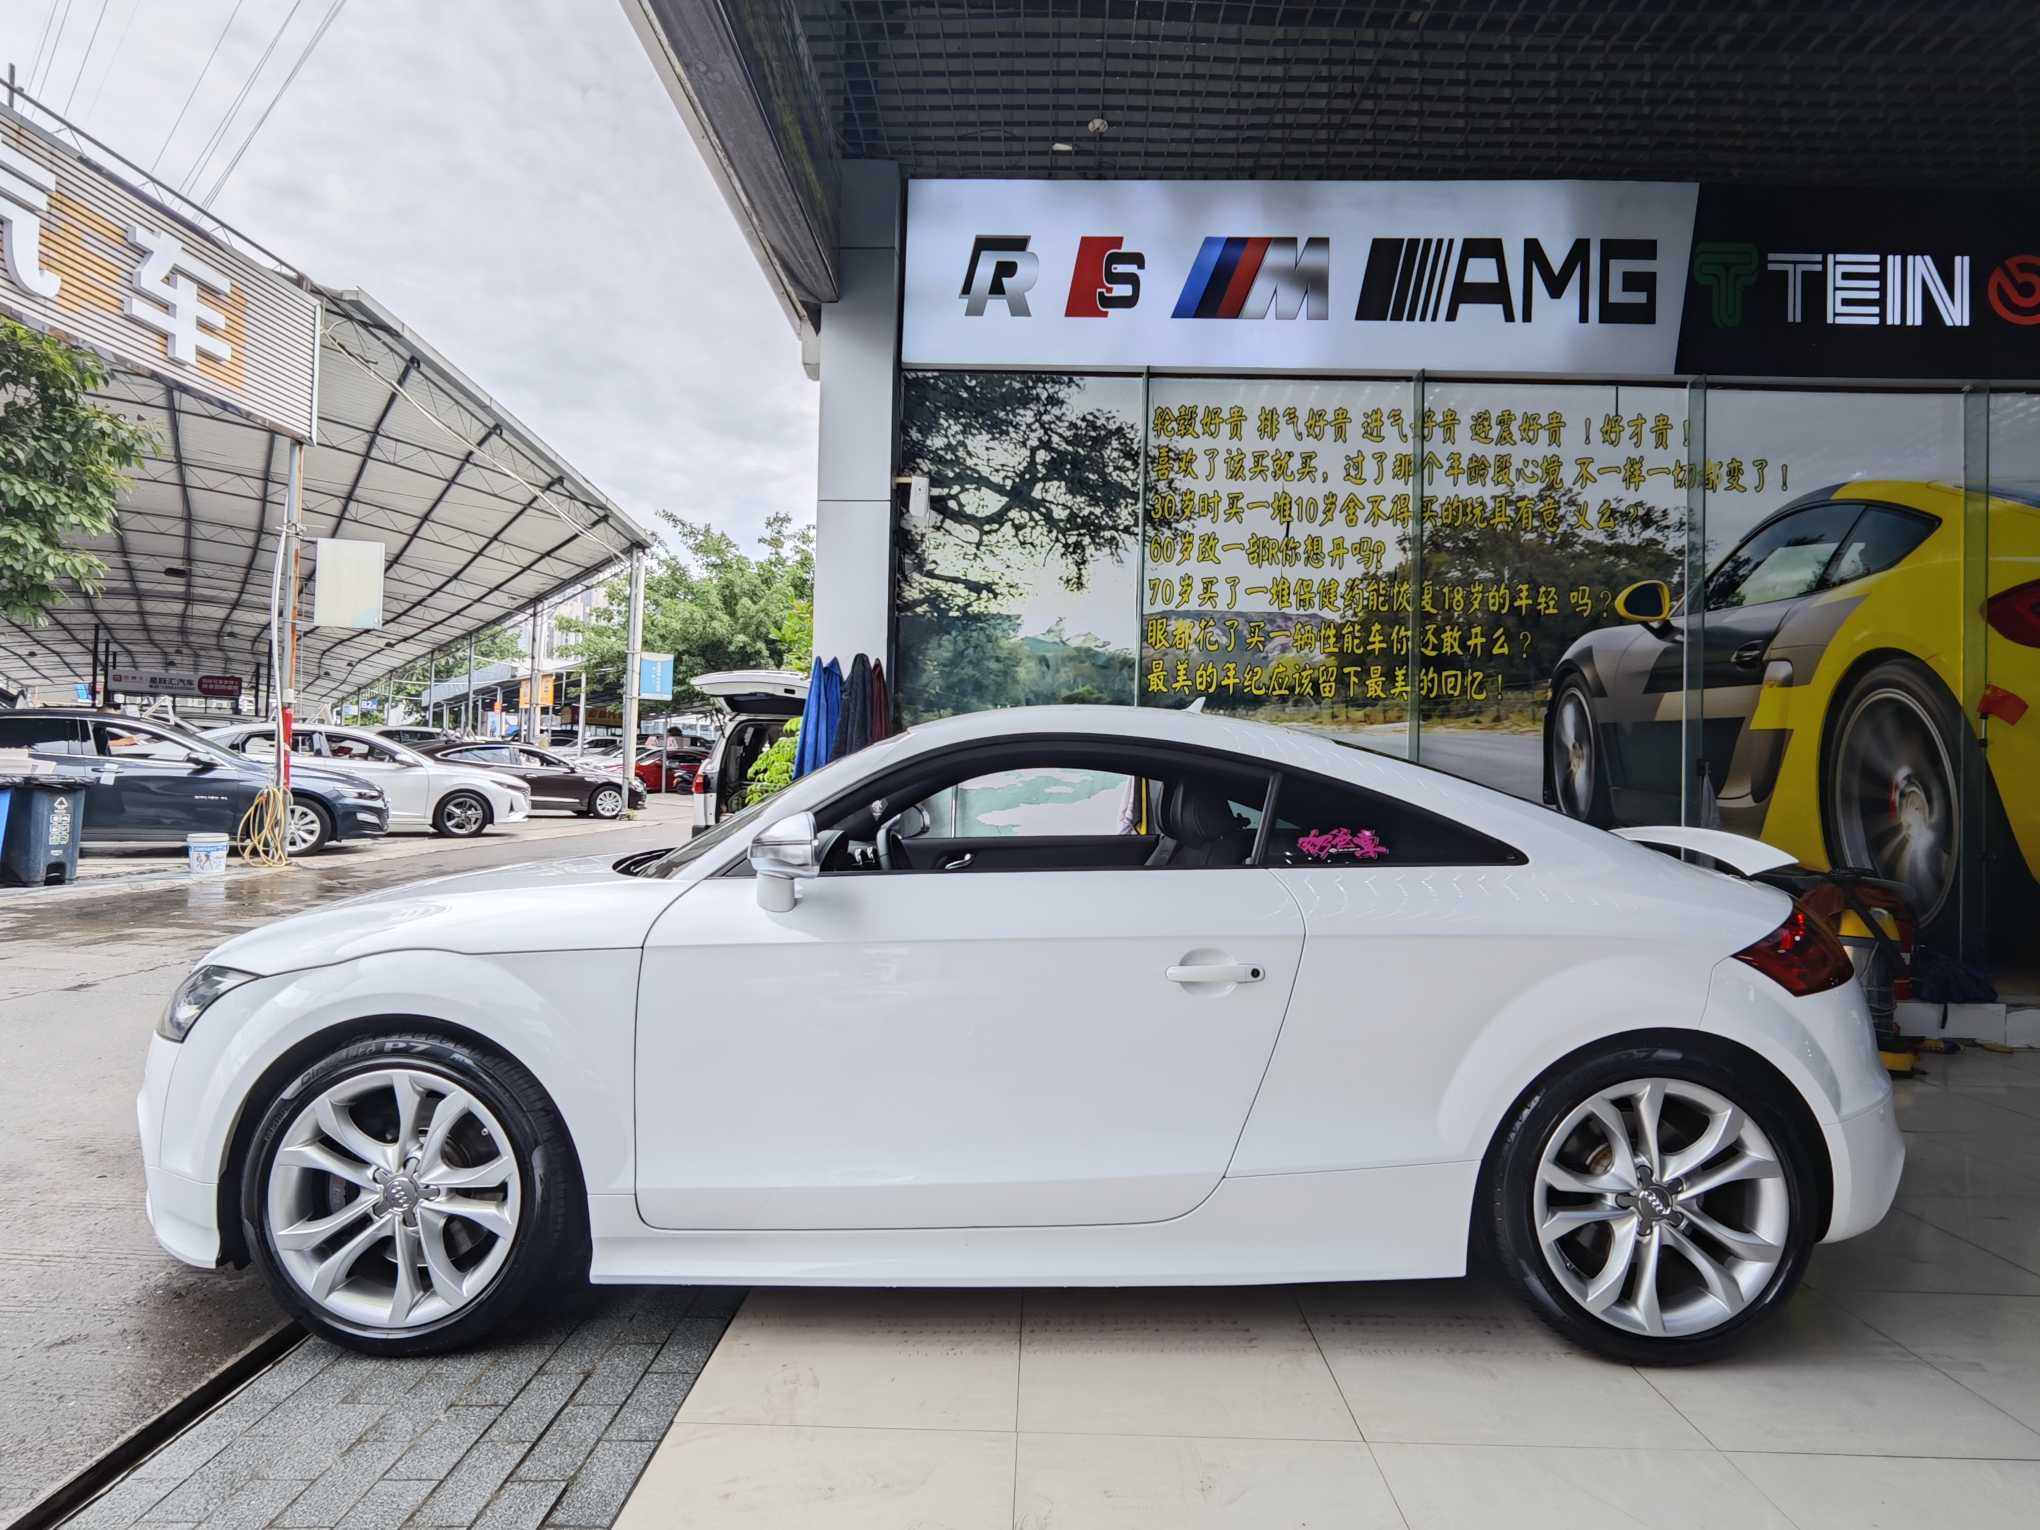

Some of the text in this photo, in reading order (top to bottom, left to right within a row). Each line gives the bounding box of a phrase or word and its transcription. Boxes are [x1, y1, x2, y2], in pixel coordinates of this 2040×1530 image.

[959, 235, 1040, 317] R
[1237, 237, 1330, 321] M
[1445, 238, 1658, 325] AMG
[1767, 252, 1970, 327] TEIN
[1258, 407, 1352, 443] 排气好贵
[383, 1039, 434, 1054] P7
